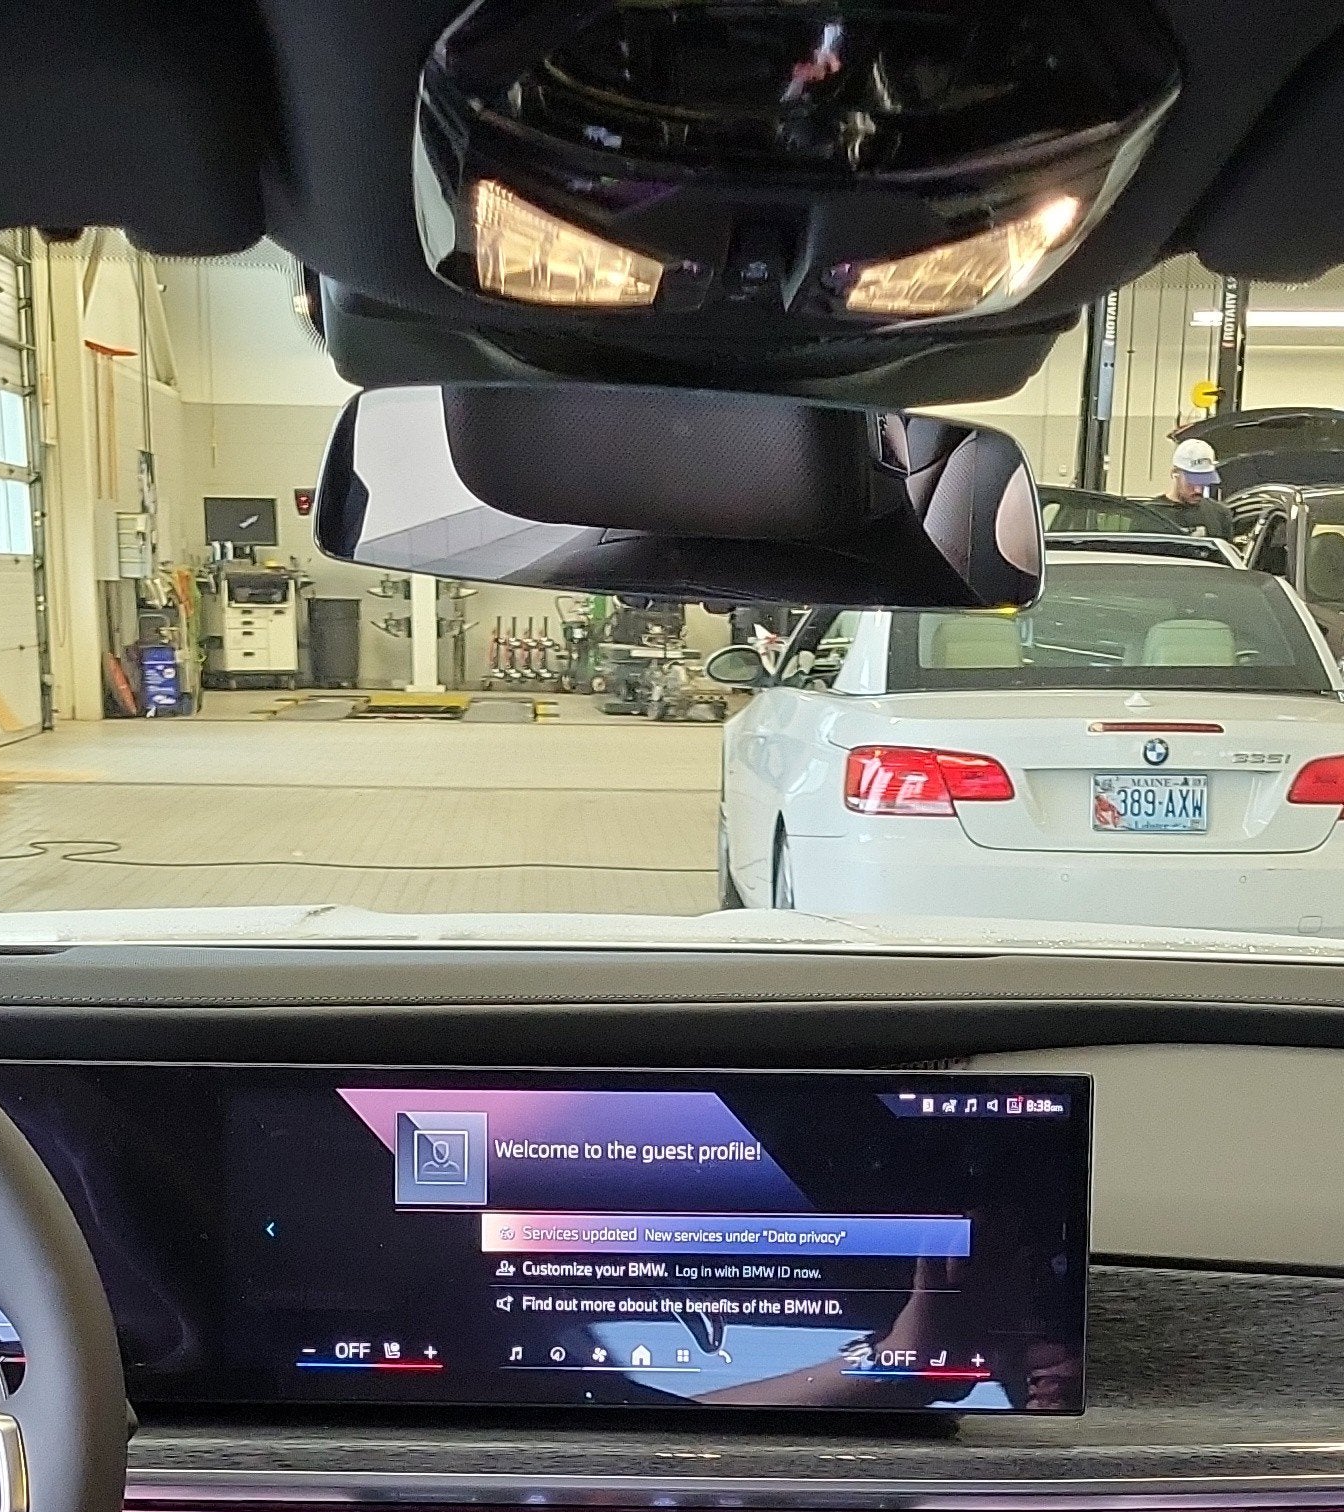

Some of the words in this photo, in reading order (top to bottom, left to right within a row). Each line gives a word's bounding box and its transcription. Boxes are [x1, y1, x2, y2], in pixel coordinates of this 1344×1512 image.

[1223, 293, 1238, 341] ROTARY
[1131, 778, 1171, 787] MAINE
[495, 1139, 579, 1159] Welcome
[584, 1142, 602, 1159] to
[607, 1140, 637, 1160] the
[642, 1143, 694, 1164] guest
[698, 1141, 762, 1165] profile!
[522, 1225, 579, 1241] Services
[582, 1227, 638, 1244] updated
[645, 1228, 672, 1242] New
[674, 1229, 723, 1243] services
[725, 1230, 761, 1243] under
[762, 1230, 797, 1244] "Data
[799, 1230, 847, 1246] privacy"
[522, 1261, 593, 1277] Customize
[595, 1265, 626, 1280] your
[628, 1262, 669, 1278] BMW.
[675, 1264, 698, 1279] Log
[701, 1264, 712, 1278] in
[714, 1265, 740, 1278] with
[742, 1266, 775, 1279] BMW
[777, 1266, 791, 1279] ID
[793, 1268, 822, 1279] now.
[522, 1296, 553, 1311] Find
[556, 1299, 578, 1312] out
[580, 1302, 616, 1312] more
[618, 1298, 658, 1313] about
[661, 1298, 683, 1313] the
[686, 1299, 740, 1314] benefits
[743, 1299, 757, 1313] of
[759, 1299, 781, 1314] the
[784, 1300, 822, 1315] BMW
[824, 1300, 843, 1315] ID.
[335, 1343, 371, 1359] OFF
[880, 1351, 917, 1367] OFF
